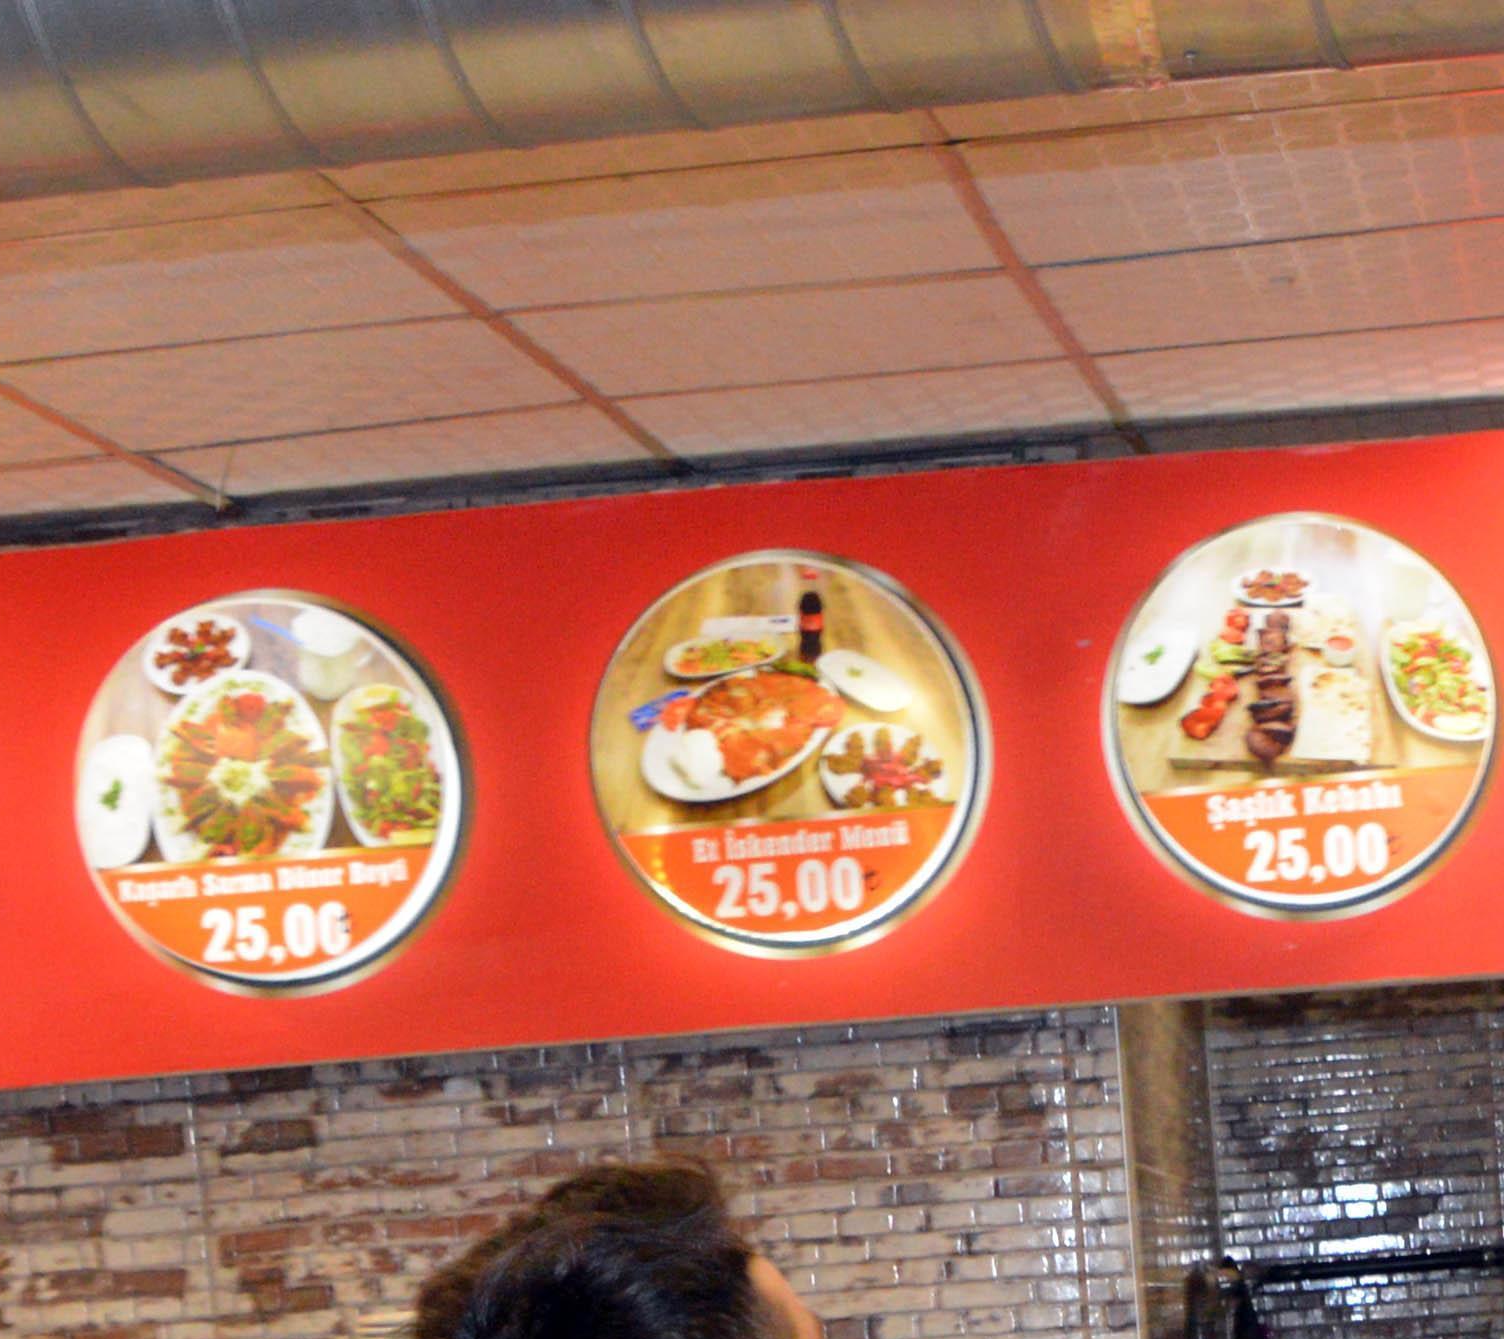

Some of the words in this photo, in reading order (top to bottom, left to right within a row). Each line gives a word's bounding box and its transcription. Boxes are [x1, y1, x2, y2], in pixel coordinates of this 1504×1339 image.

[691, 837, 721, 865] Et
[723, 828, 834, 861] İskender
[1244, 822, 1391, 885] 25,00
[712, 855, 865, 921] 25,00
